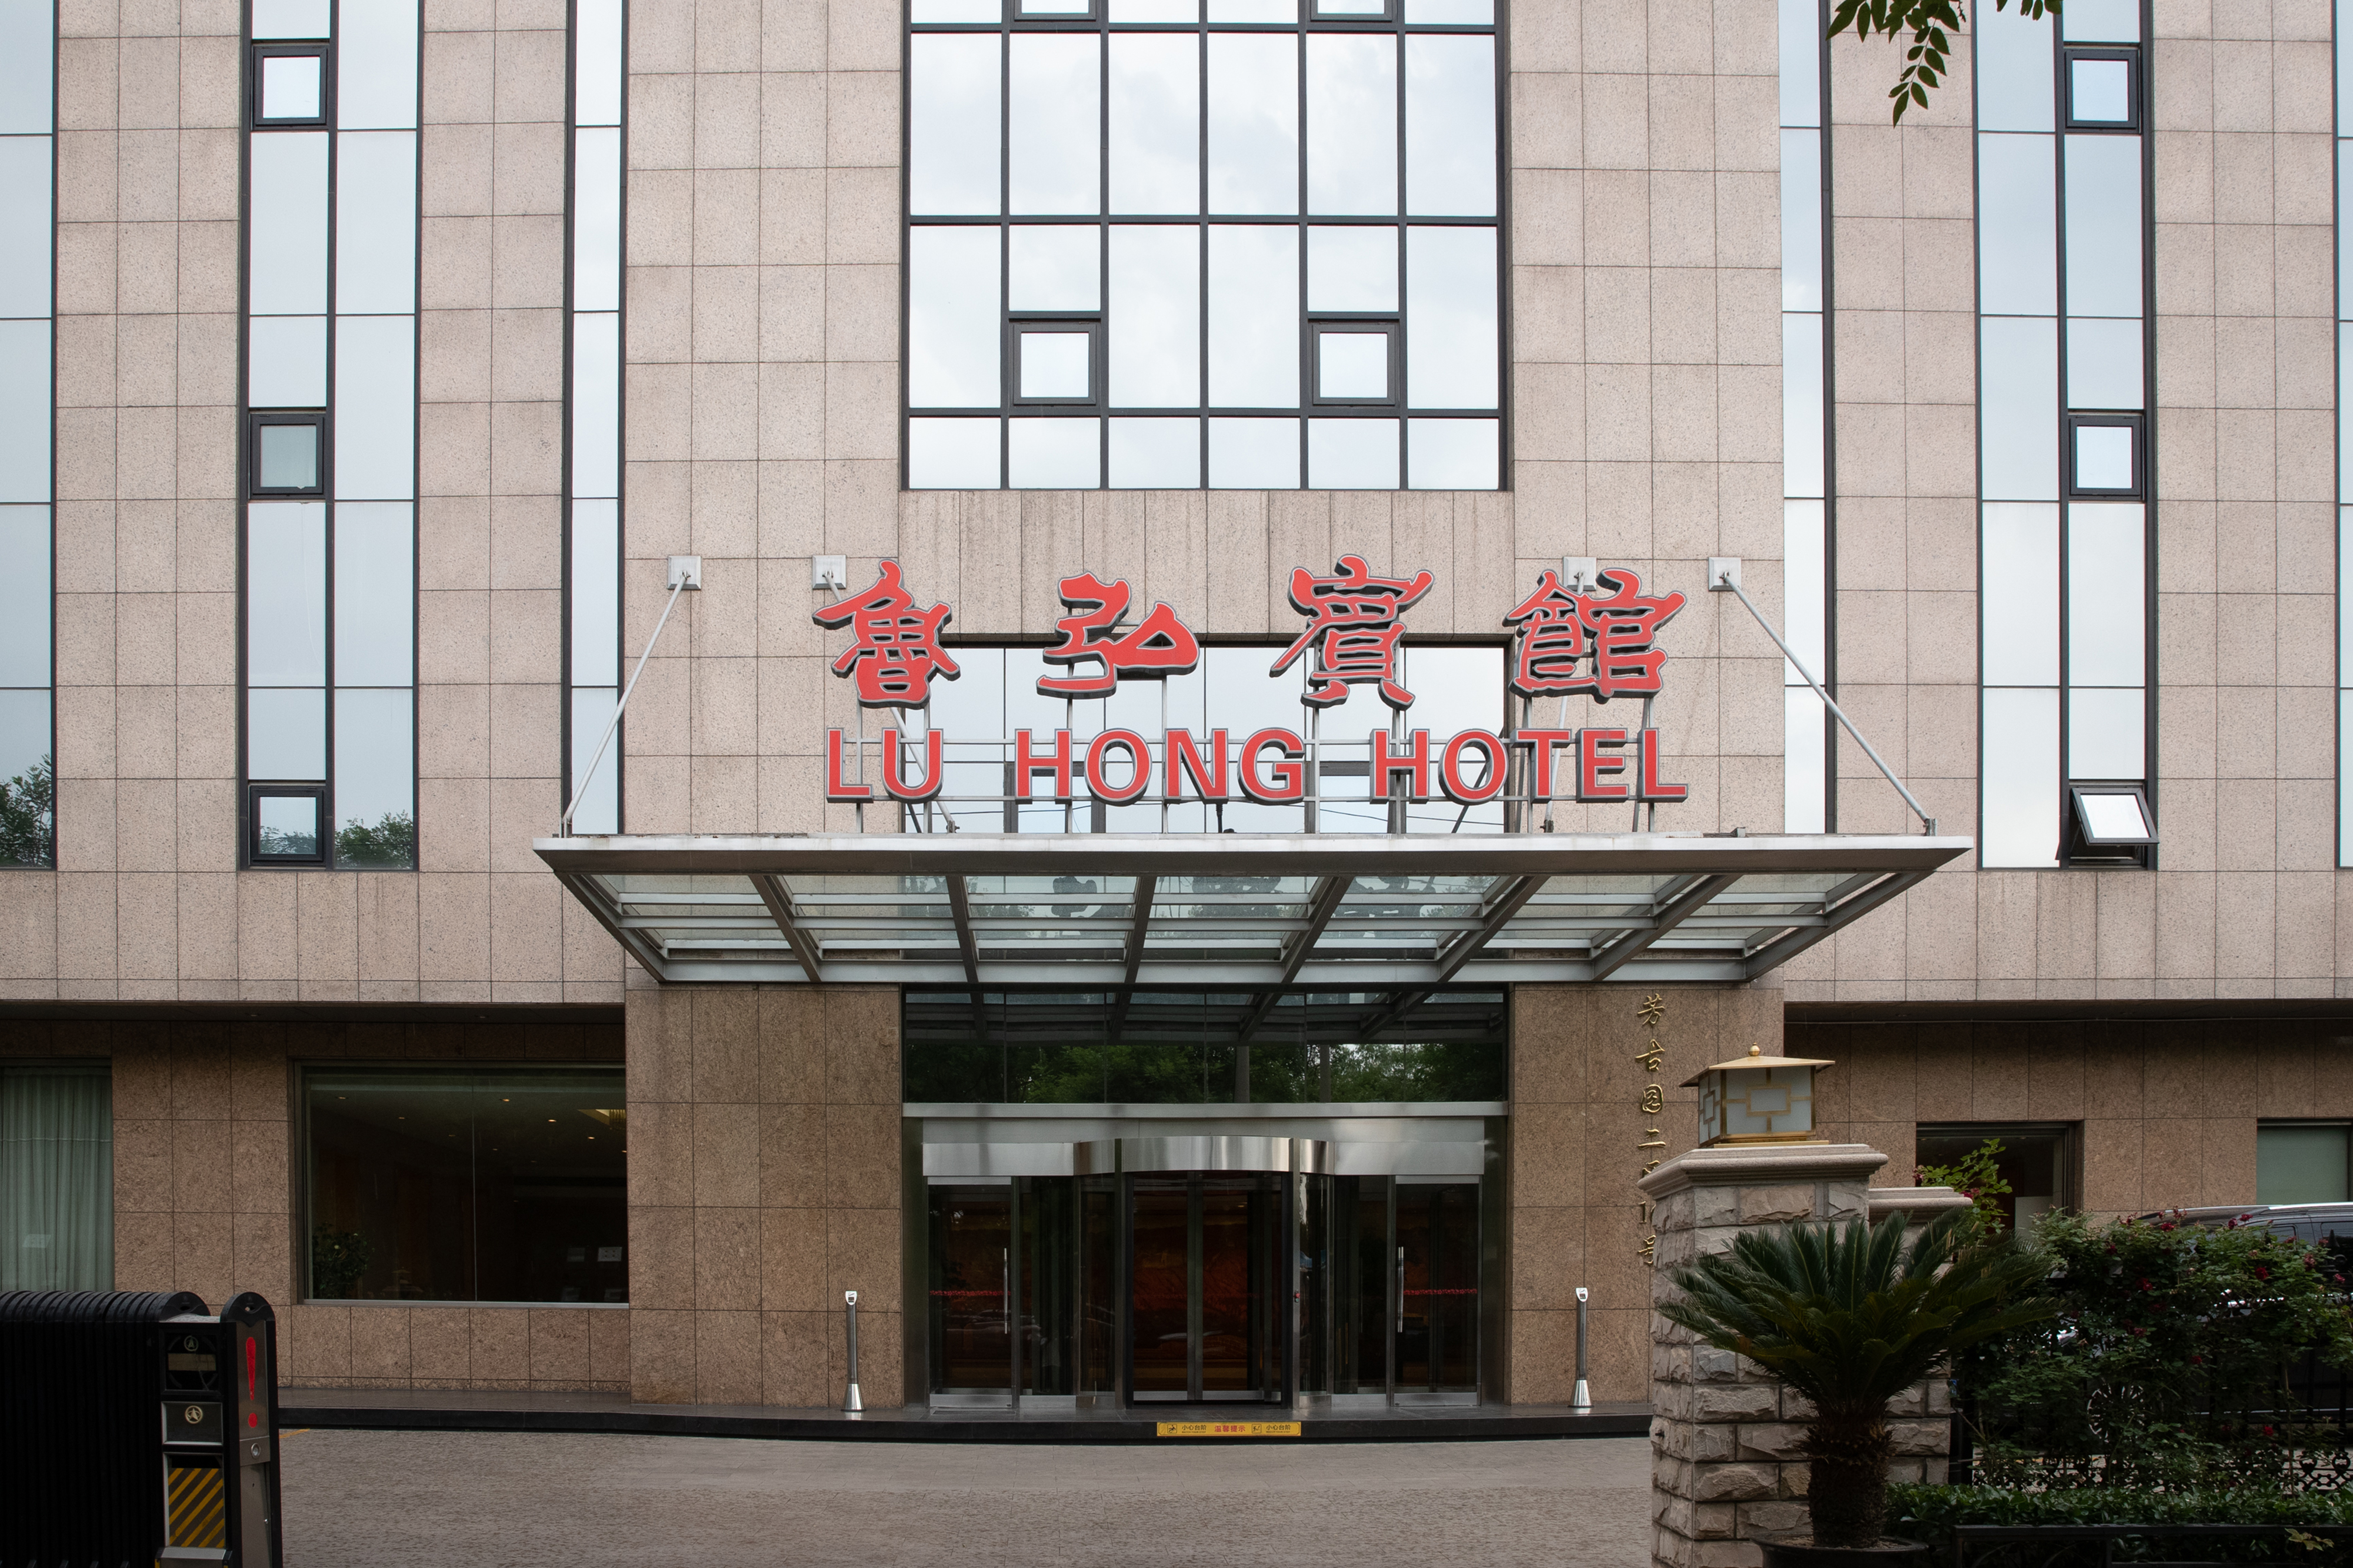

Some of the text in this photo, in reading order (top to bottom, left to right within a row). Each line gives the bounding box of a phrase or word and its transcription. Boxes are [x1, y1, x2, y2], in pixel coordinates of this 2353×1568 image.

[826, 727, 1689, 806] LU HONG HOTEL
